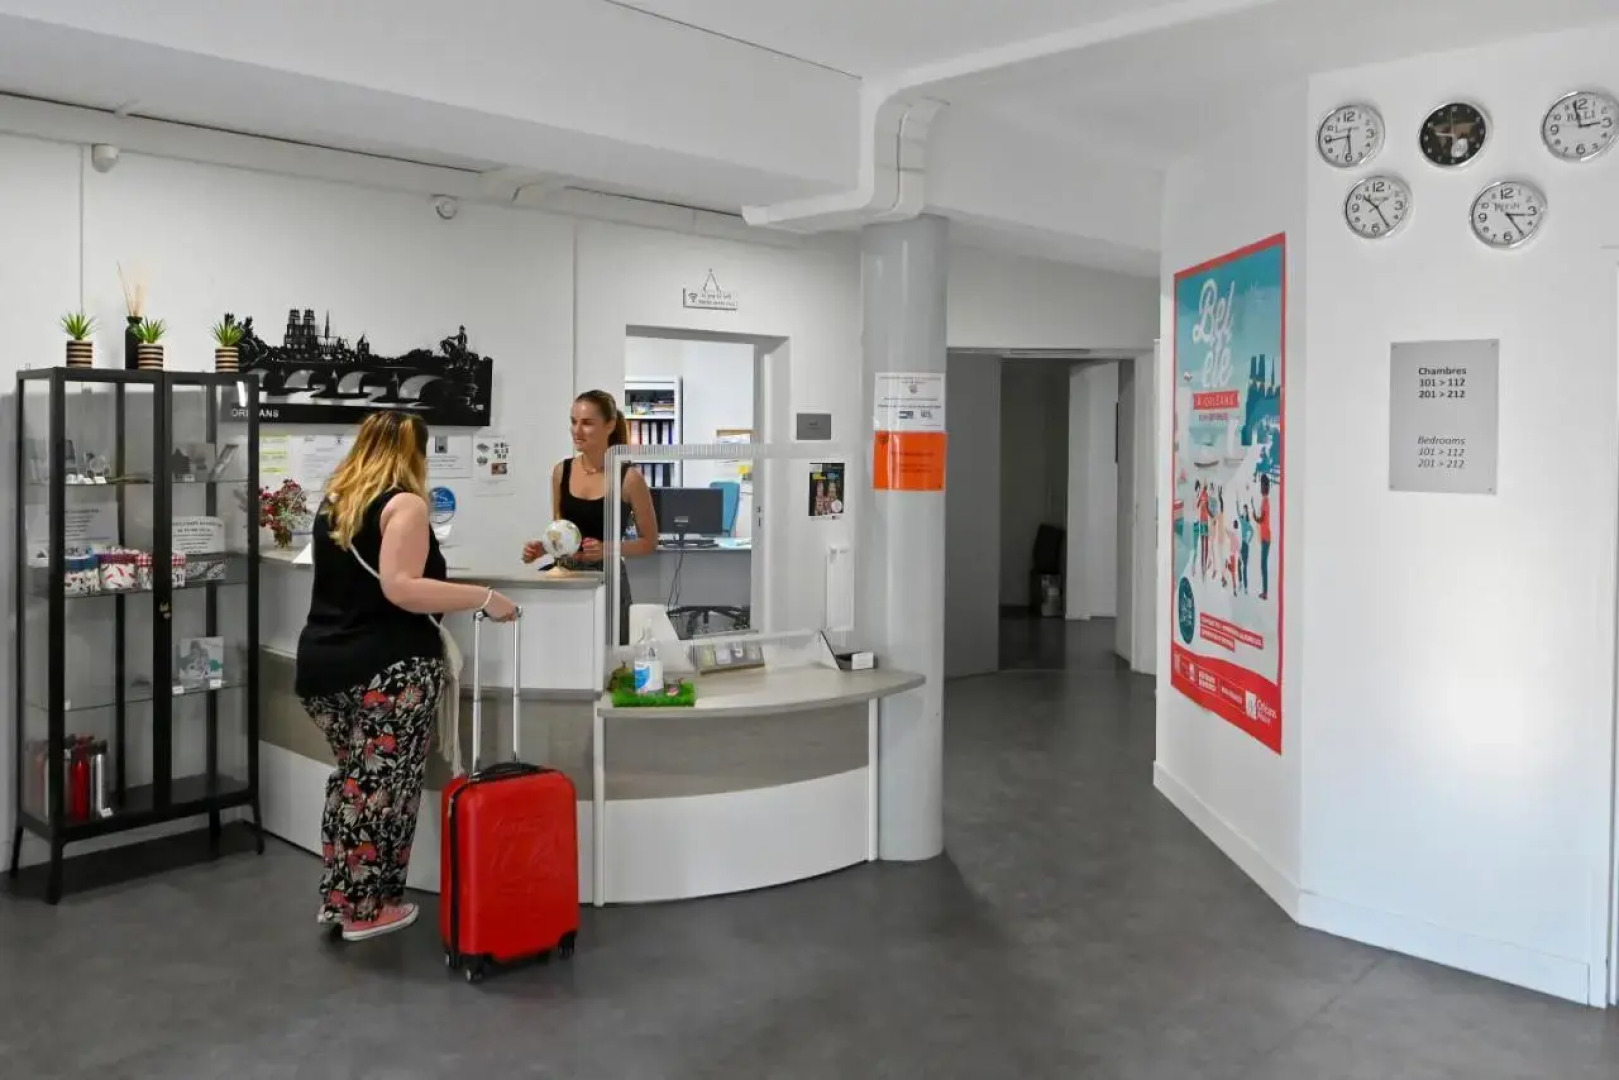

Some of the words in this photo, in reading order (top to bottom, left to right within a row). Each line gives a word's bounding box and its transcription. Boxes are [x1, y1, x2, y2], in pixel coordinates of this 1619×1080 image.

[1343, 111, 1356, 122] 12
[1550, 124, 1559, 136] 9
[1575, 143, 1586, 155] 6
[1372, 181, 1385, 192] 12
[1500, 187, 1514, 200] 12
[1351, 203, 1360, 213] 9
[1394, 200, 1404, 211] 3
[1418, 367, 1467, 375] Chambres
[1420, 378, 1436, 387] 101
[1447, 378, 1466, 387] 112
[1418, 390, 1436, 399] 201
[1447, 390, 1466, 398] 212
[1417, 436, 1466, 445] Bedrooms
[1419, 447, 1435, 456] 101
[1446, 448, 1465, 457] 112
[1417, 459, 1435, 468] 201
[1446, 459, 1465, 468] 212
